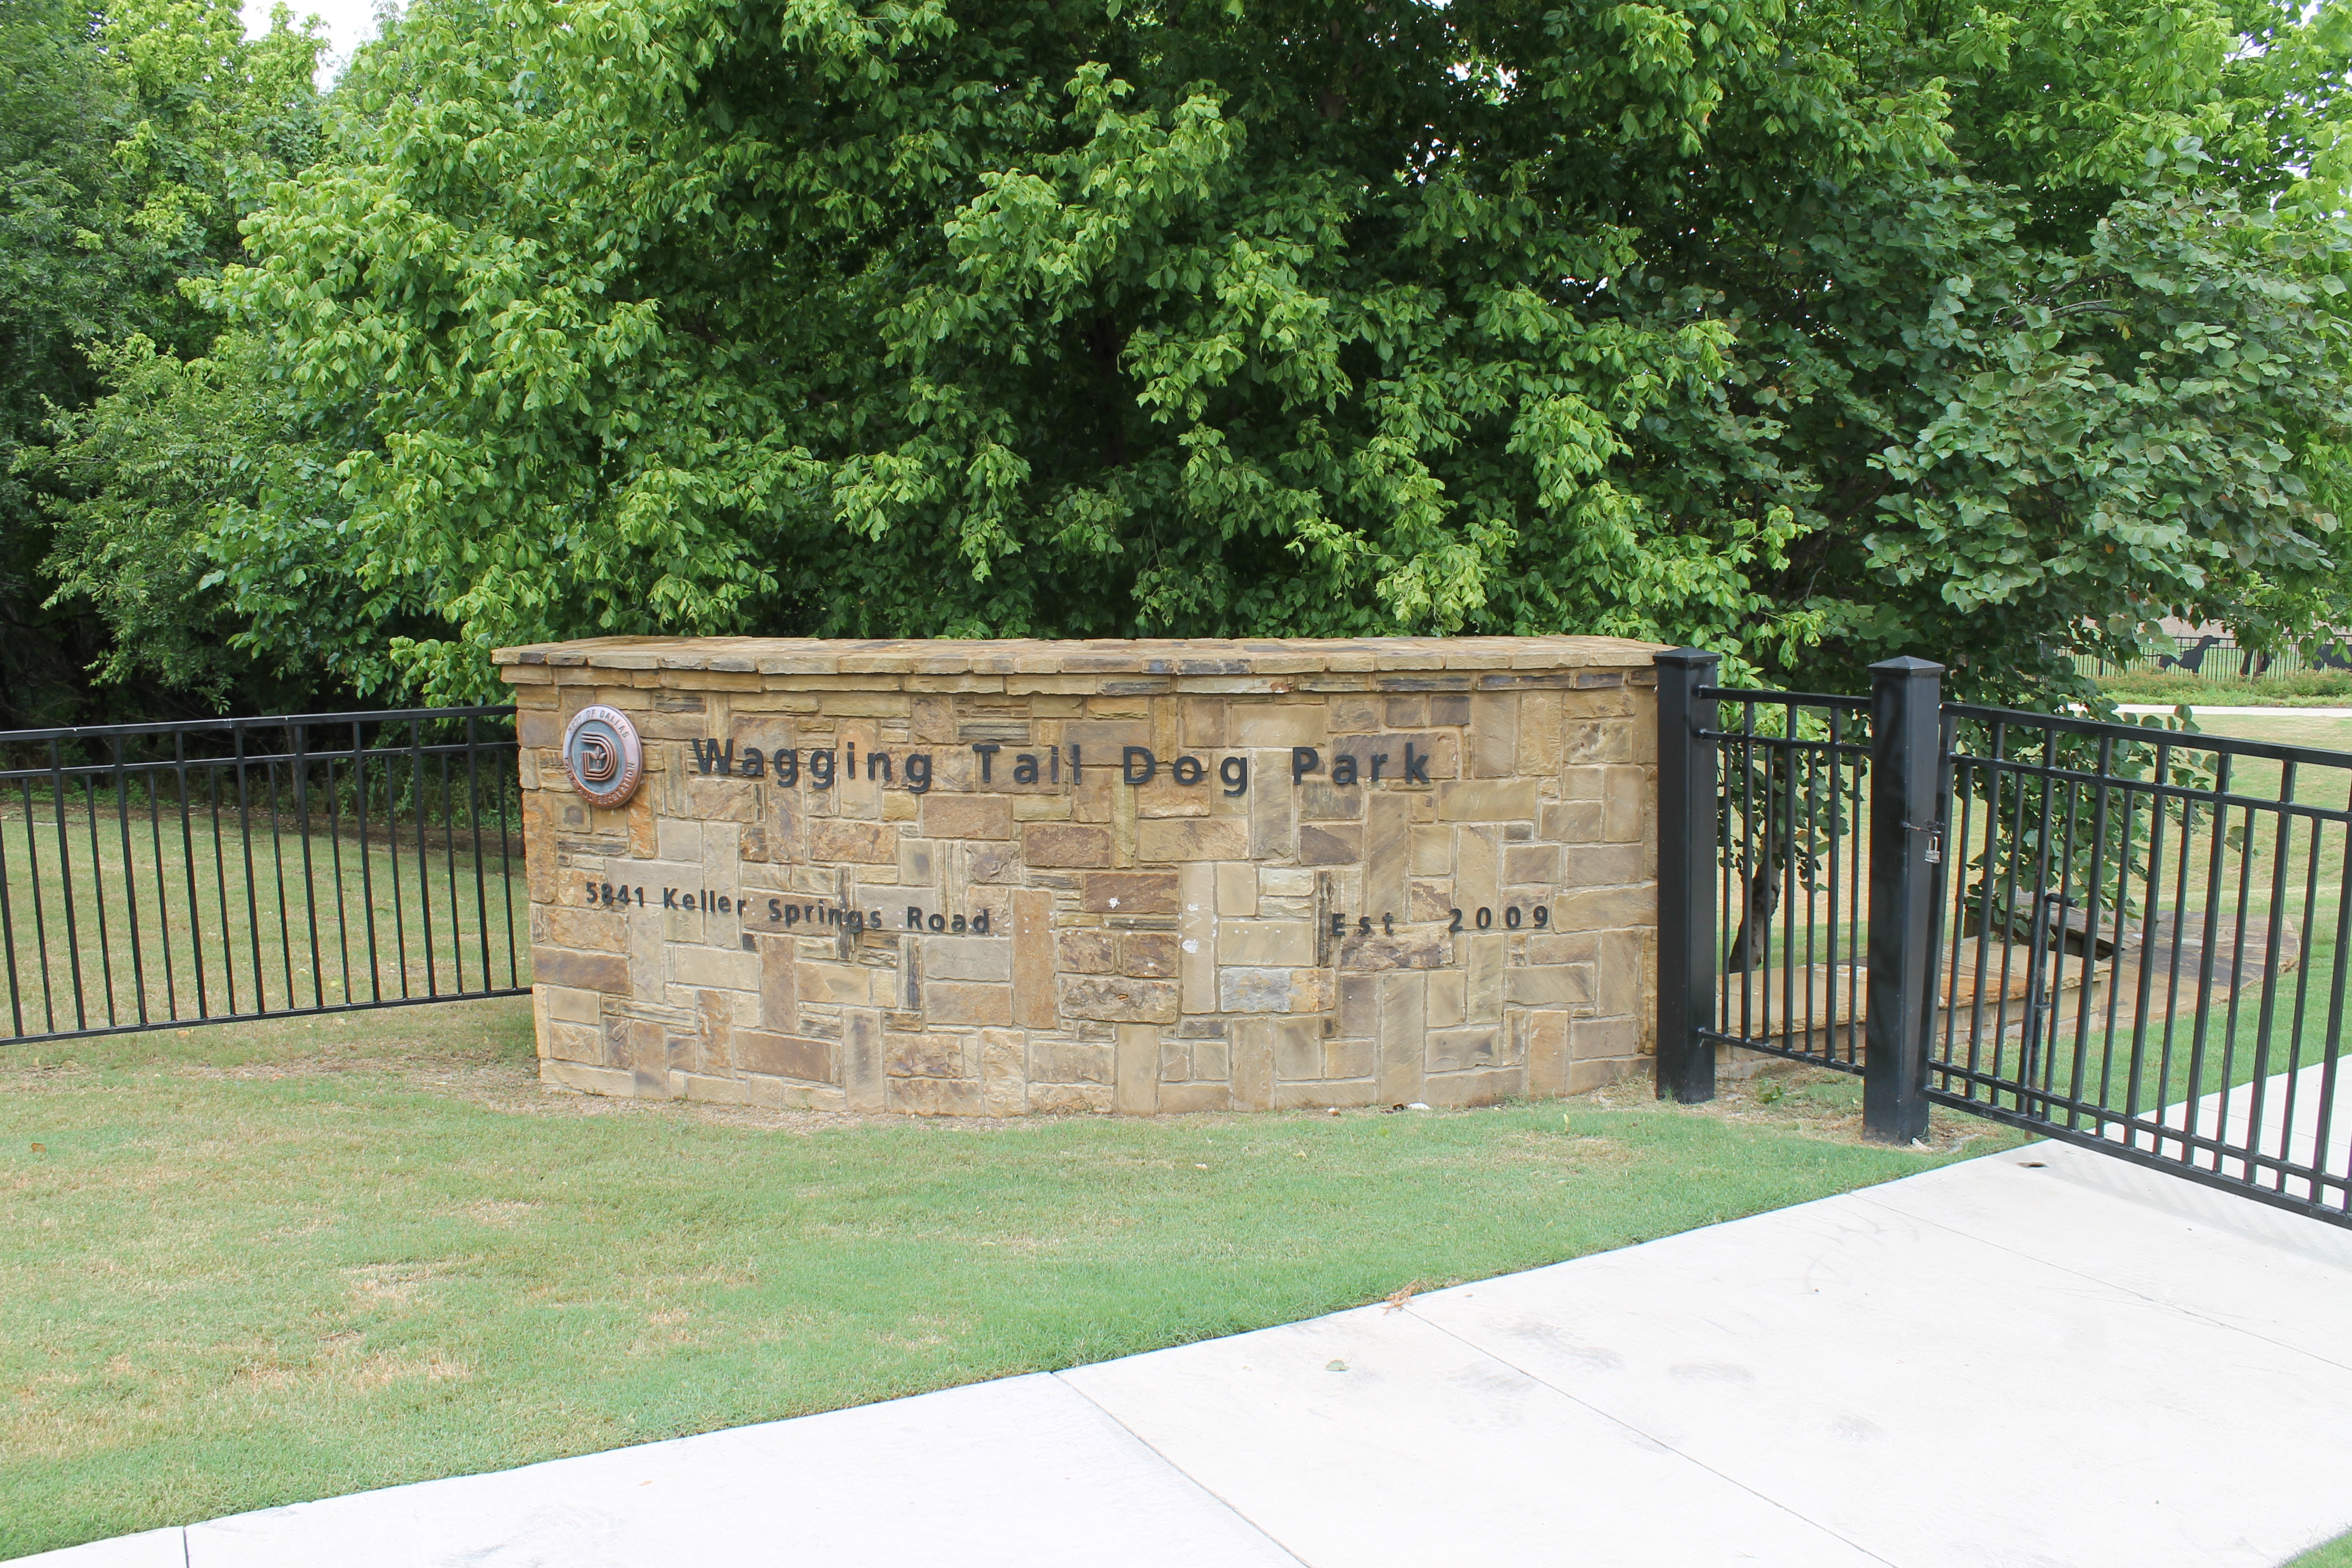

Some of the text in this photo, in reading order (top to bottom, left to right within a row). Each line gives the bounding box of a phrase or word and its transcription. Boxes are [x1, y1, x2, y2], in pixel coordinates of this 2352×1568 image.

[586, 709, 596, 718] OF
[600, 710, 630, 739] DALLAS
[692, 737, 1430, 797] Wagging Tail Dog Park
[585, 881, 990, 934] 5841 Keller Springs Road
[1330, 905, 1549, 937] Est 2009
